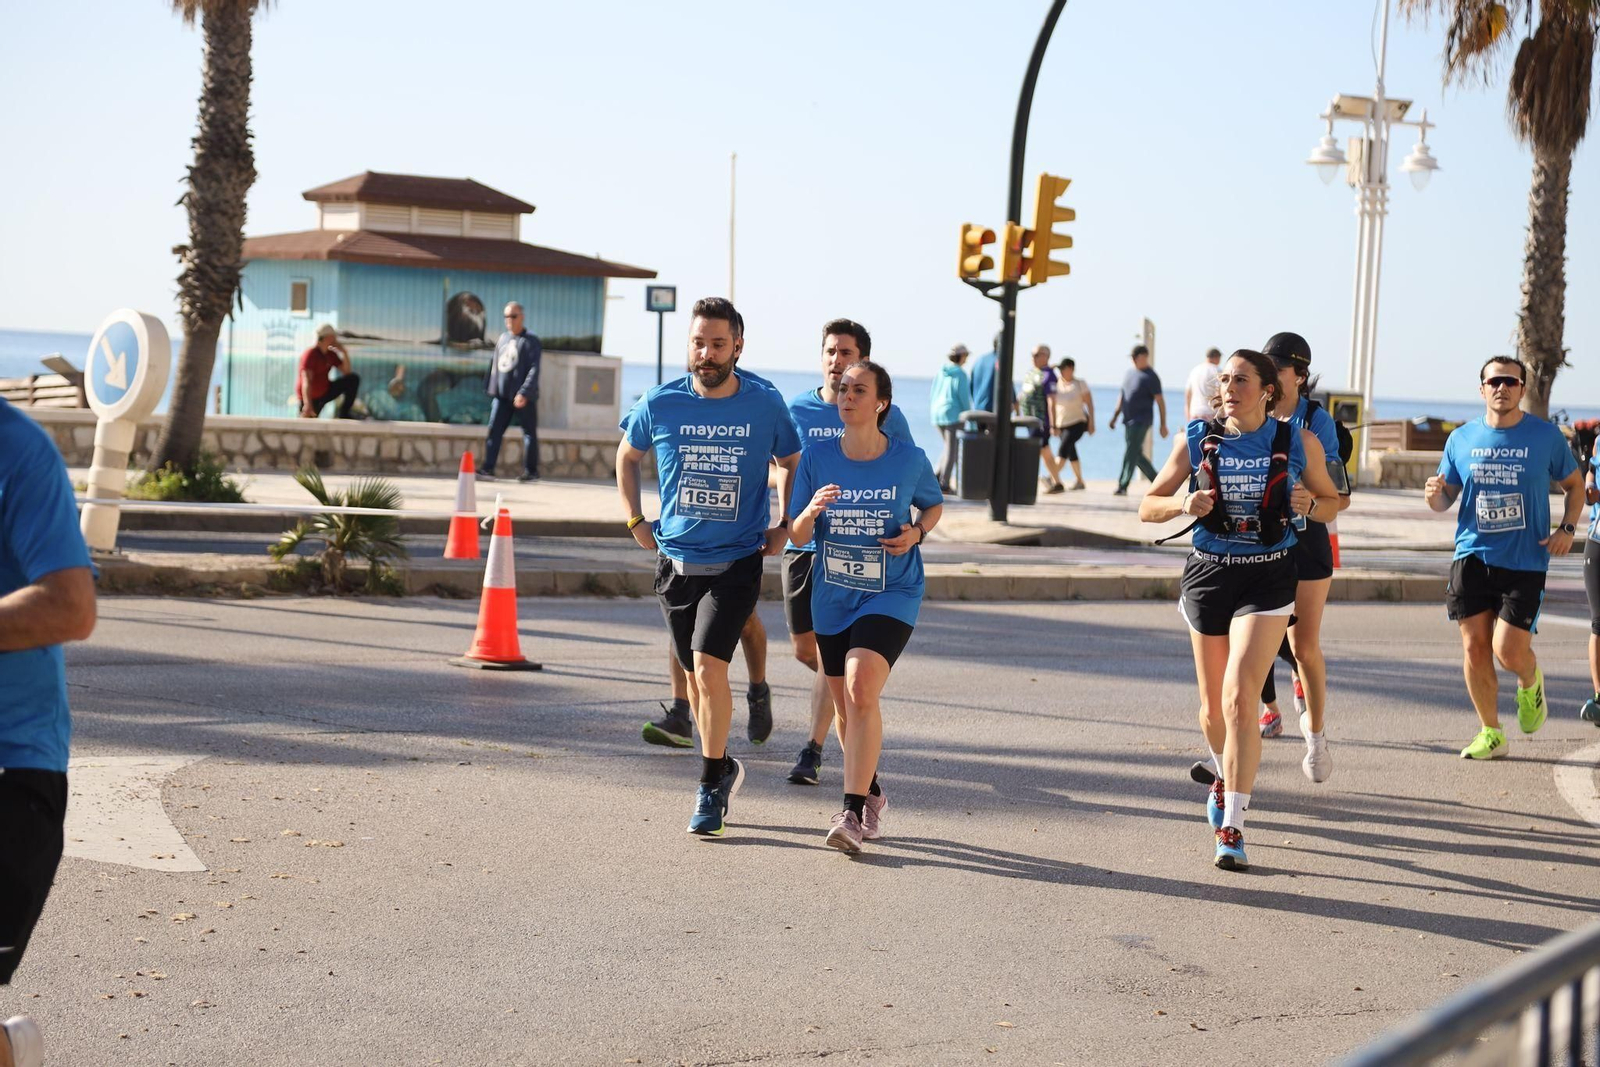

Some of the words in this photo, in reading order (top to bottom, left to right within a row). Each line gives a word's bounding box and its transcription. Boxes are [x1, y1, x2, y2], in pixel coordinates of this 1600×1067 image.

[680, 423, 750, 439] mayoral
[679, 445, 744, 456] RUNNING
[1471, 447, 1528, 459] mayoral
[685, 454, 738, 464] MAKES
[1219, 457, 1270, 470] ayora
[683, 462, 738, 473] FRIENDS
[1219, 474, 1267, 484] UNNIN
[685, 490, 731, 506] 1654
[1222, 492, 1264, 500] RIEND
[826, 509, 890, 519] RUNNING
[1481, 507, 1517, 519] 2013
[831, 518, 885, 527] MAKES
[829, 527, 885, 536] FRIENDS
[1193, 547, 1219, 563] DER
[1221, 551, 1281, 565] ARMOUR
[842, 562, 864, 576] 12
